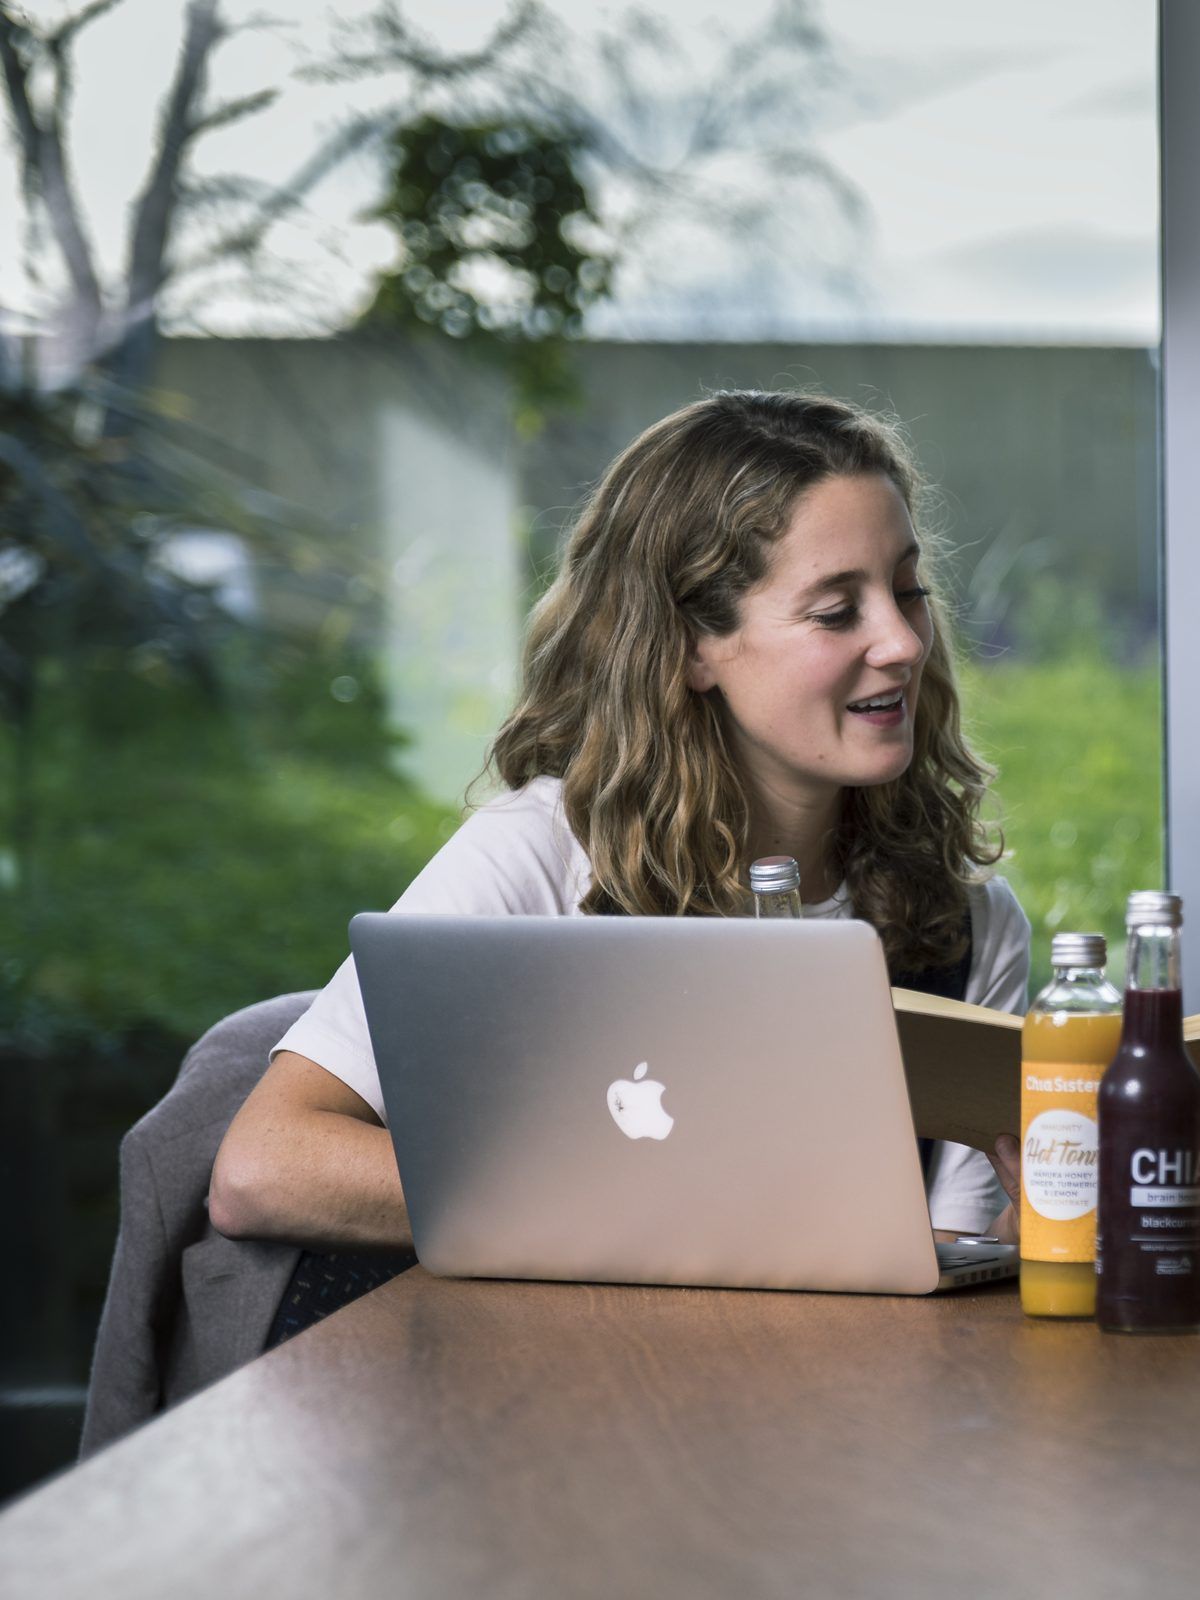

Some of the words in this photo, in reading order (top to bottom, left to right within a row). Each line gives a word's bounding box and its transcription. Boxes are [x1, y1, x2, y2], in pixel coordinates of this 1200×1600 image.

[1054, 1077, 1100, 1093] Sister
[1027, 1137, 1057, 1165] Hot
[1064, 1172, 1093, 1181] HONEY
[1147, 1192, 1175, 1203] brain
